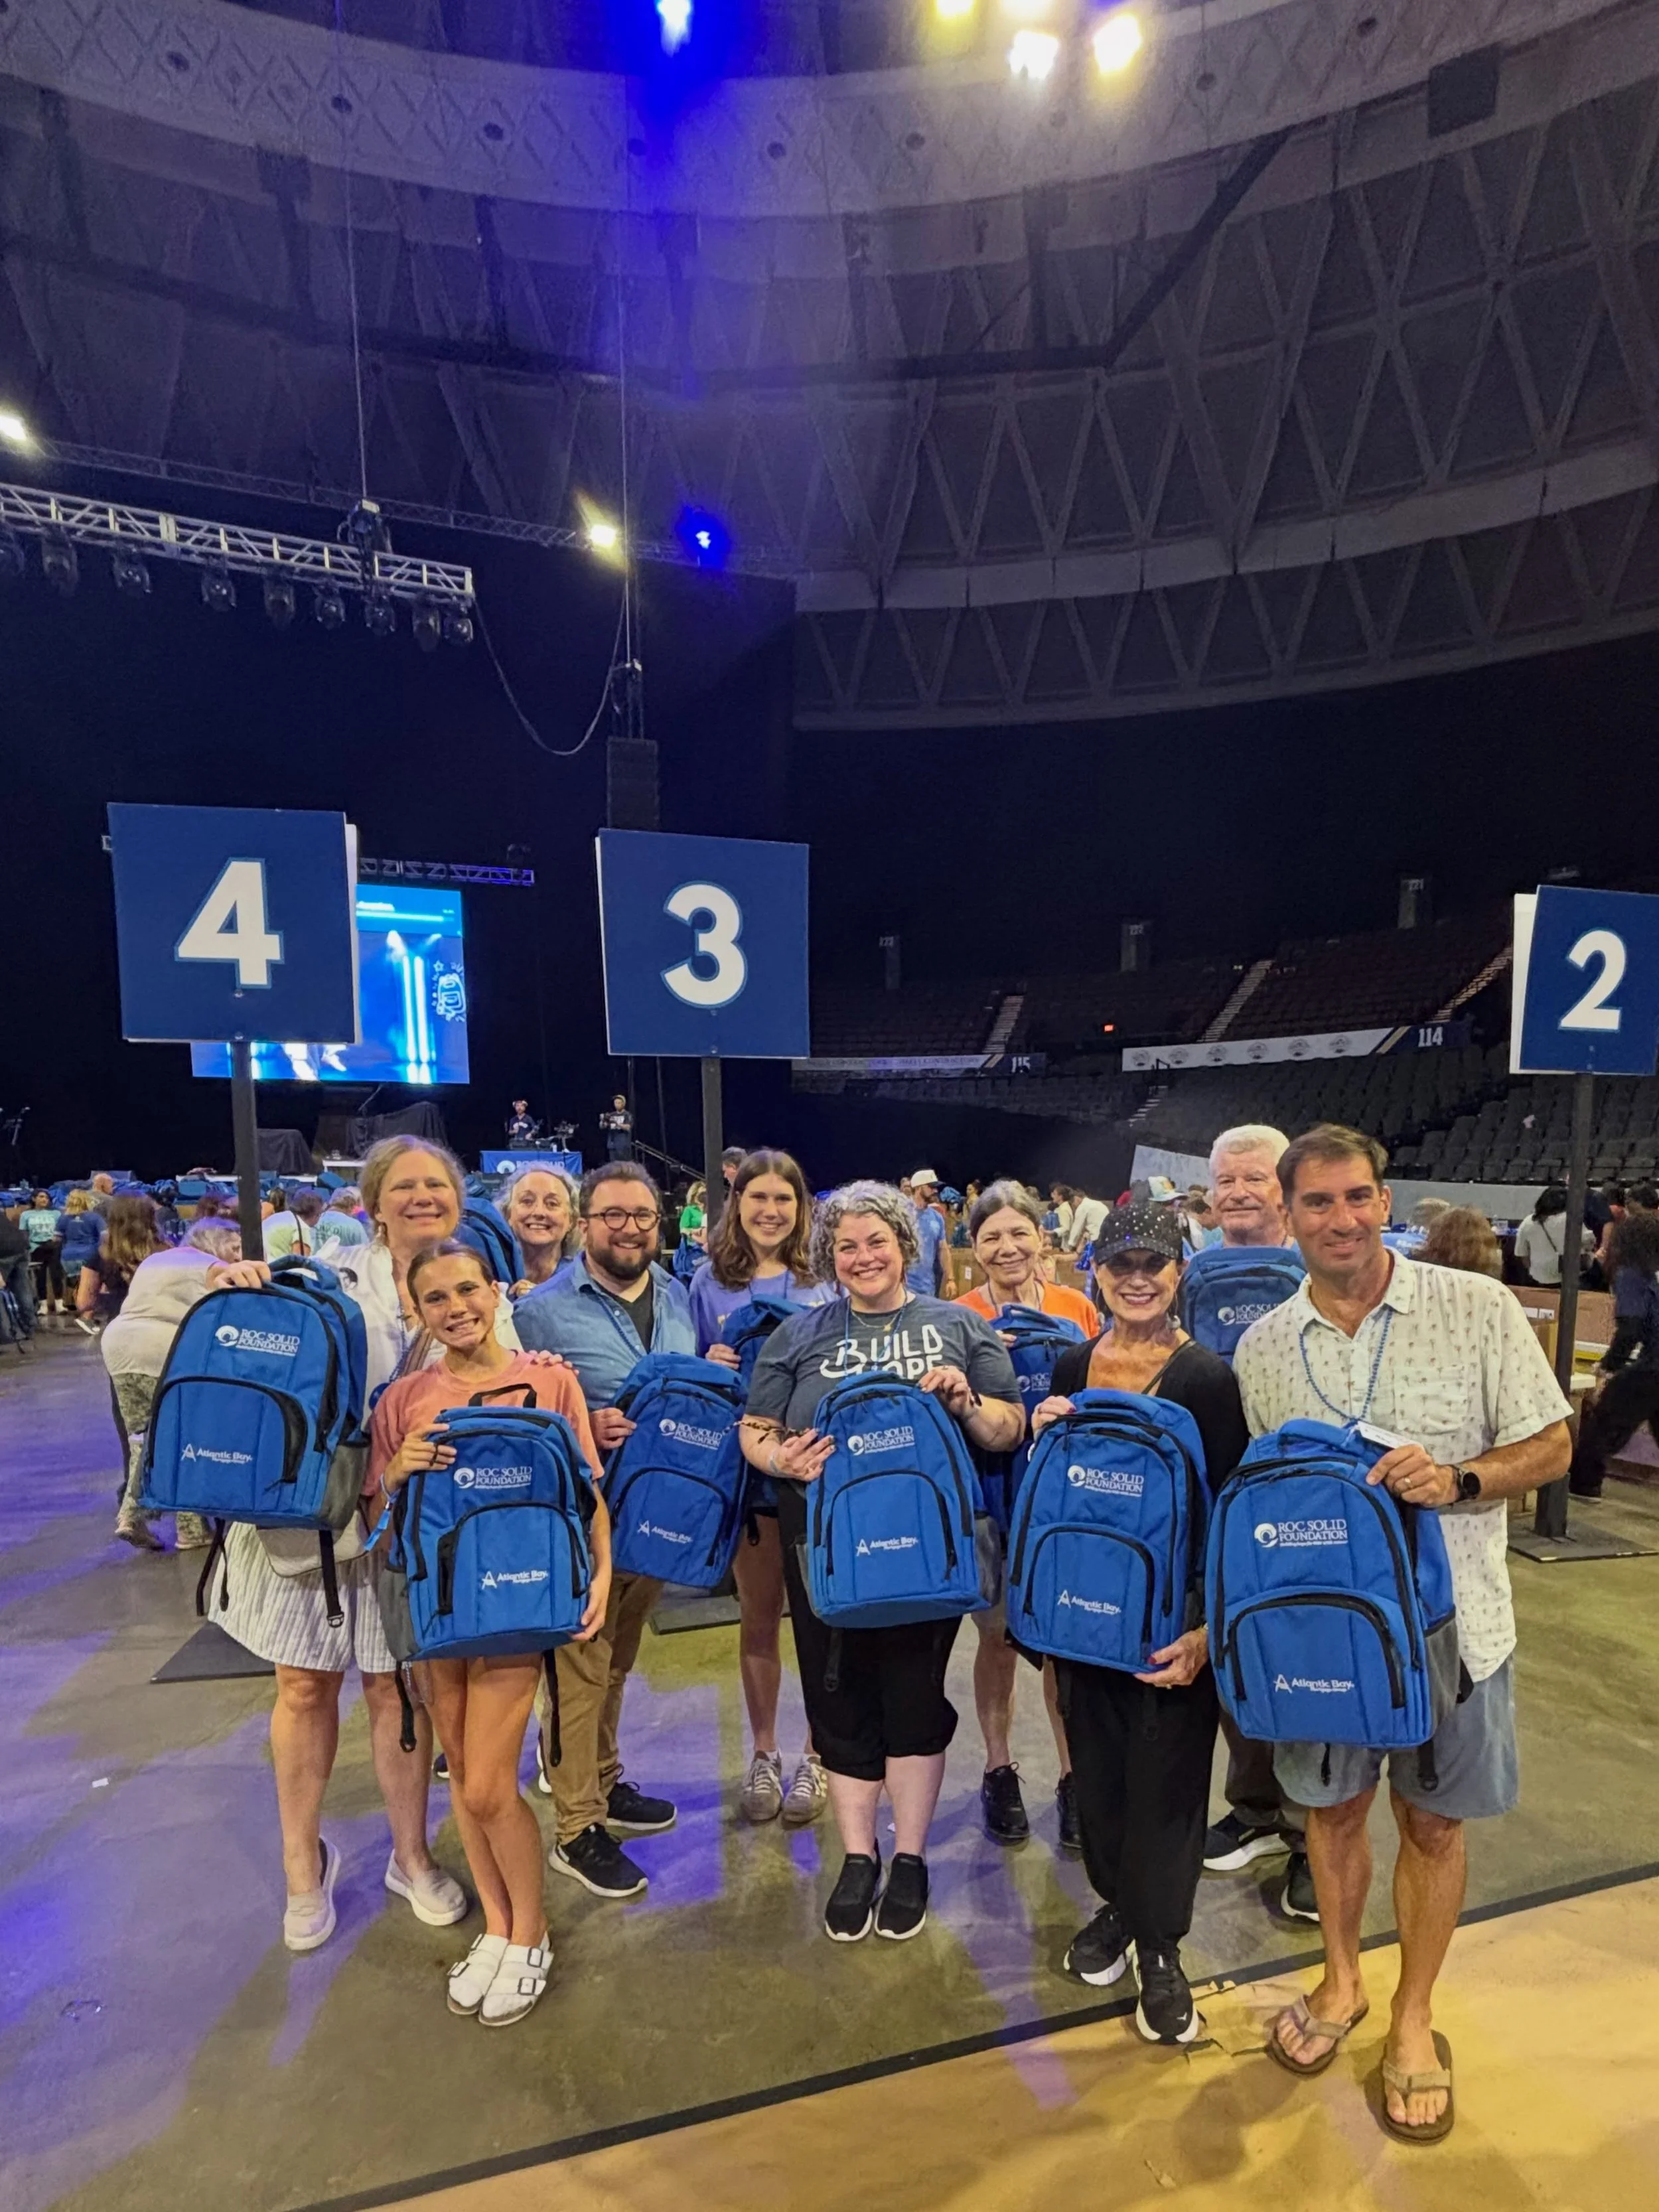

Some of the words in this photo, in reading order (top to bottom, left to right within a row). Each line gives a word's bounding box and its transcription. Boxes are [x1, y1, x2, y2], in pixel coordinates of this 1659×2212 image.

[177, 859, 282, 987] 4
[662, 882, 747, 1007] 3
[1560, 929, 1626, 1031] 2
[1418, 1027, 1443, 1047] 114
[1011, 1056, 1031, 1073] 115
[1256, 1303, 1281, 1313] SOL
[239, 1337, 298, 1353] FOUNDATION
[241, 1329, 265, 1341] ROC
[267, 1333, 300, 1346] SOLID
[820, 1324, 943, 1376] BUILD
[675, 1431, 720, 1447] FOUNDATION
[676, 1422, 697, 1435] ROC
[698, 1428, 722, 1440] SOLID
[863, 1431, 883, 1442] ROC
[884, 1426, 913, 1438] SOLID
[864, 1434, 914, 1449] FOUNDATION
[197, 1448, 231, 1459] Atlantic
[233, 1452, 251, 1462] Bay
[476, 1467, 500, 1477] ROC
[501, 1466, 532, 1477] SOLID
[1087, 1467, 1110, 1480] ROC
[1111, 1471, 1144, 1485] SOLID
[476, 1475, 532, 1485] FOUNDATION
[1086, 1477, 1143, 1493] FOUNDATION
[1278, 1522, 1305, 1532] ROC
[1307, 1519, 1346, 1531] SOLID
[869, 1538, 901, 1548] Atlantic
[1279, 1530, 1348, 1542] FOUNDATION
[497, 1572, 530, 1582] Atlantic
[1071, 1595, 1102, 1609] Atlantic
[1292, 1677, 1331, 1688] Atlantic
[1331, 1679, 1352, 1690] Bay
